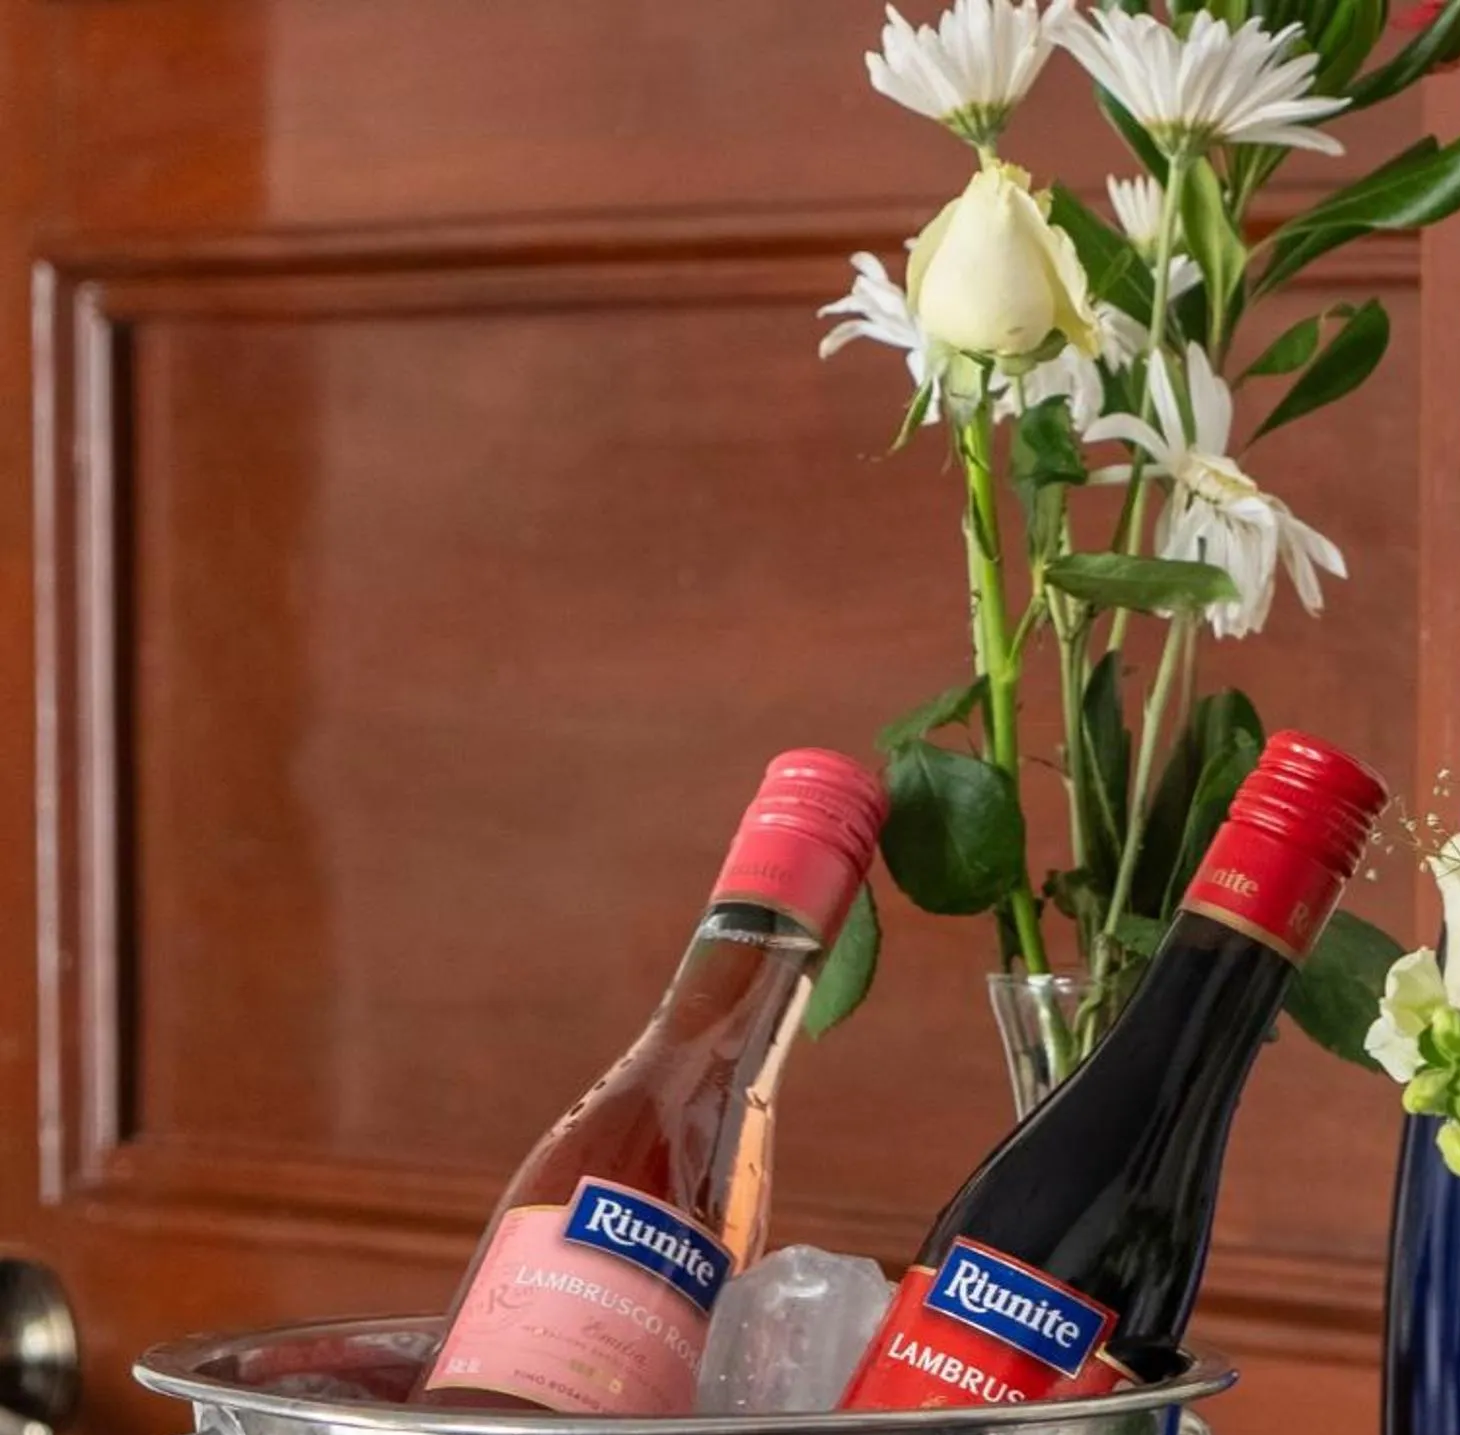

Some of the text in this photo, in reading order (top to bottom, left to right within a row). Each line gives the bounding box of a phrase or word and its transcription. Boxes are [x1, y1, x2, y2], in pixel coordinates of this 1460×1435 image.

[1212, 868, 1260, 898] nite
[585, 1197, 715, 1287] Riunite
[515, 1264, 663, 1335] LAMBRUSCO
[944, 1259, 1081, 1348] Riunite
